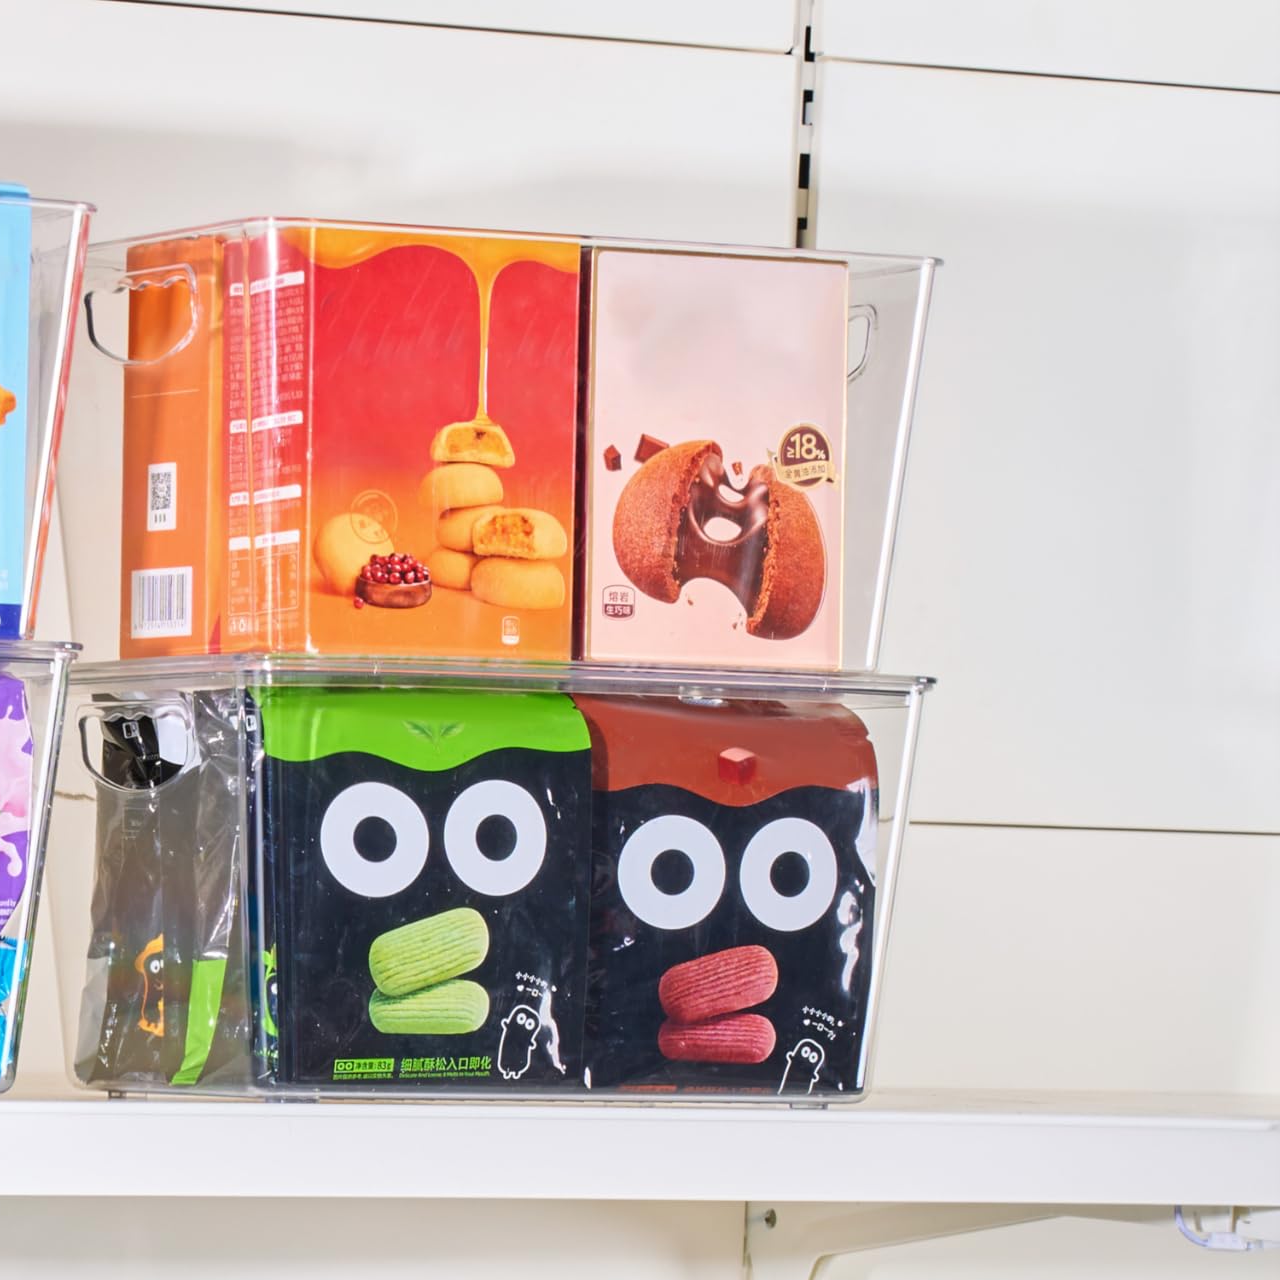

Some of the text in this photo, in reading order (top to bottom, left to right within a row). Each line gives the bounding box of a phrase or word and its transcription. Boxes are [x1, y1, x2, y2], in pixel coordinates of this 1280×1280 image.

[401, 1056, 492, 1072] 细腻酥松入口即化
